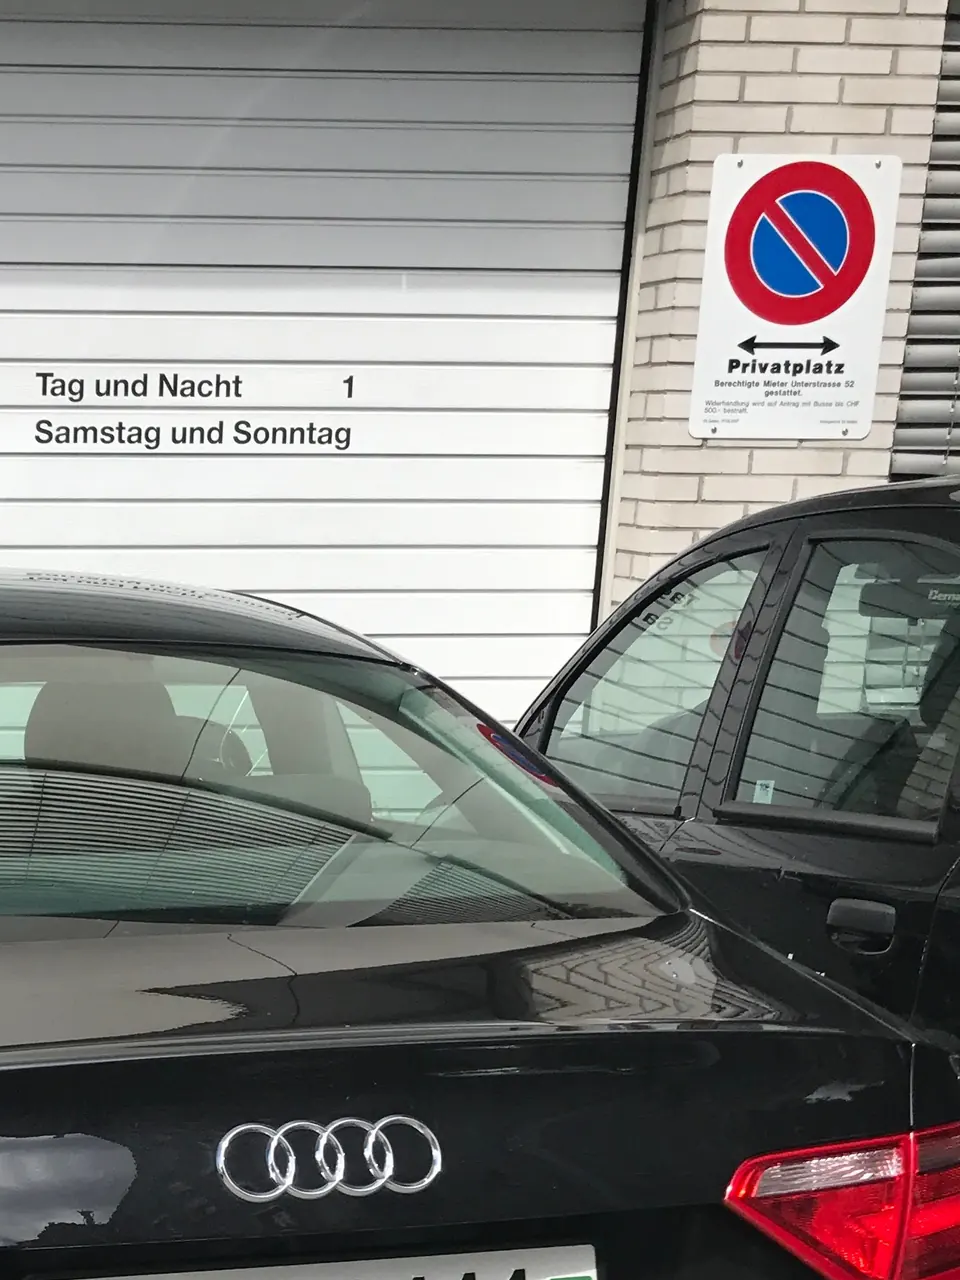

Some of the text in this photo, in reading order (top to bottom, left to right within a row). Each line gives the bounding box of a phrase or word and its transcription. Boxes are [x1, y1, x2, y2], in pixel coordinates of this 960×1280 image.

[728, 359, 844, 376] Privatplatz
[36, 373, 353, 402] Tag und Nacht 1
[715, 380, 855, 388] Berechtigte Mieter Unterstrasse 52
[35, 420, 350, 450] Samstag und Sonntag
